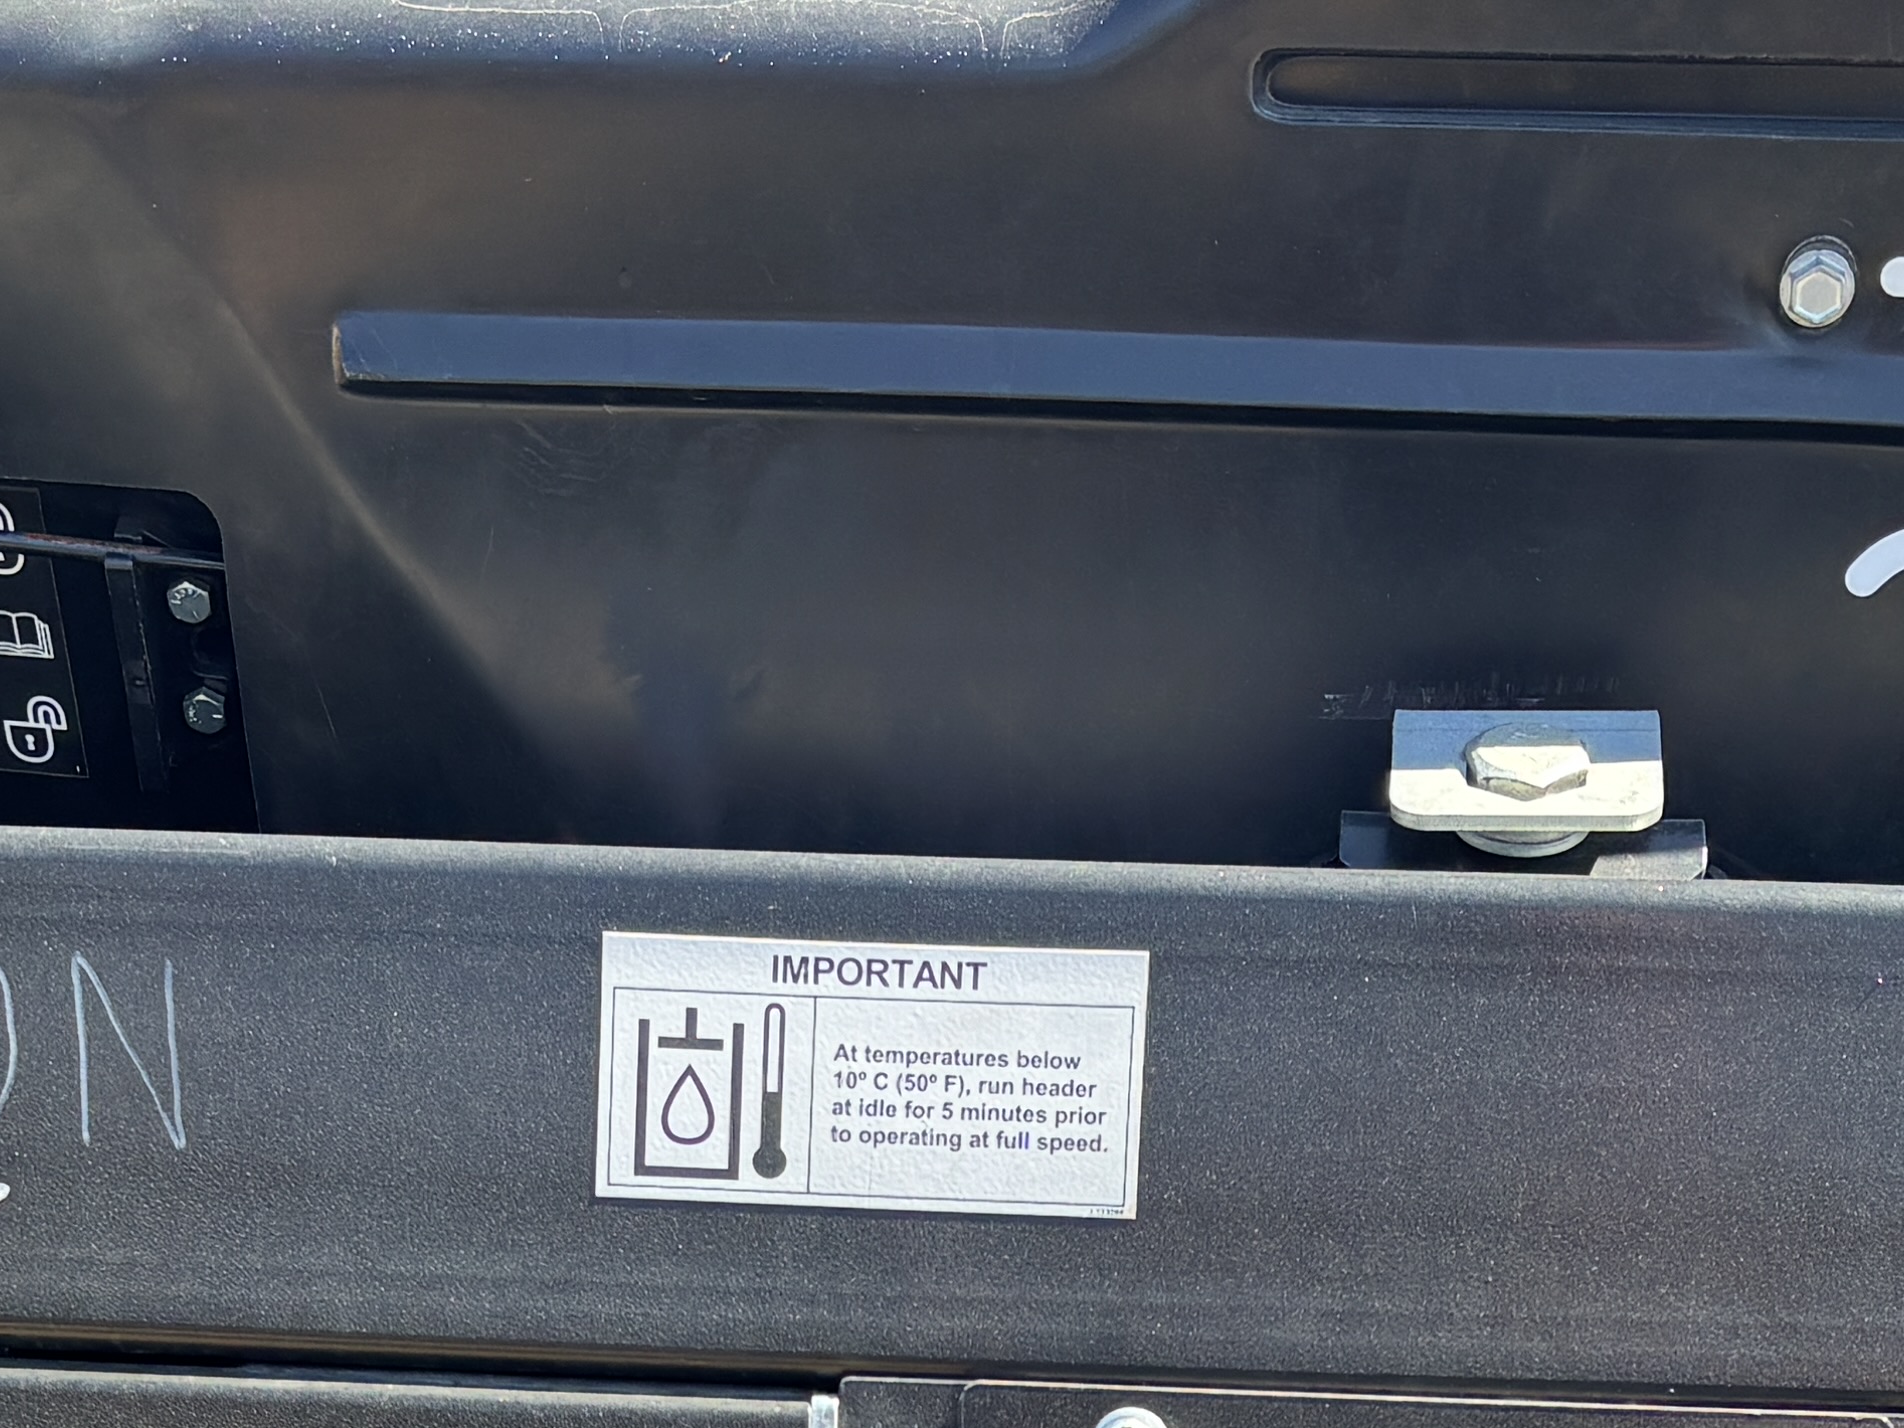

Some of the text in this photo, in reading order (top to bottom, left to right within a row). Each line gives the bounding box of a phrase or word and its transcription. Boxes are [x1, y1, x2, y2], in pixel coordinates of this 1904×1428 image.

[771, 954, 988, 990] IMPORTANT
[834, 1044, 1081, 1071] At temperatures below
[873, 1072, 889, 1092] C
[944, 1074, 971, 1098] F),
[978, 1079, 1014, 1097] run
[1021, 1078, 1097, 1099] header
[832, 1098, 1107, 1131] at idle for 5 minutes prior
[831, 1126, 1109, 1155] to operating at full speed.
